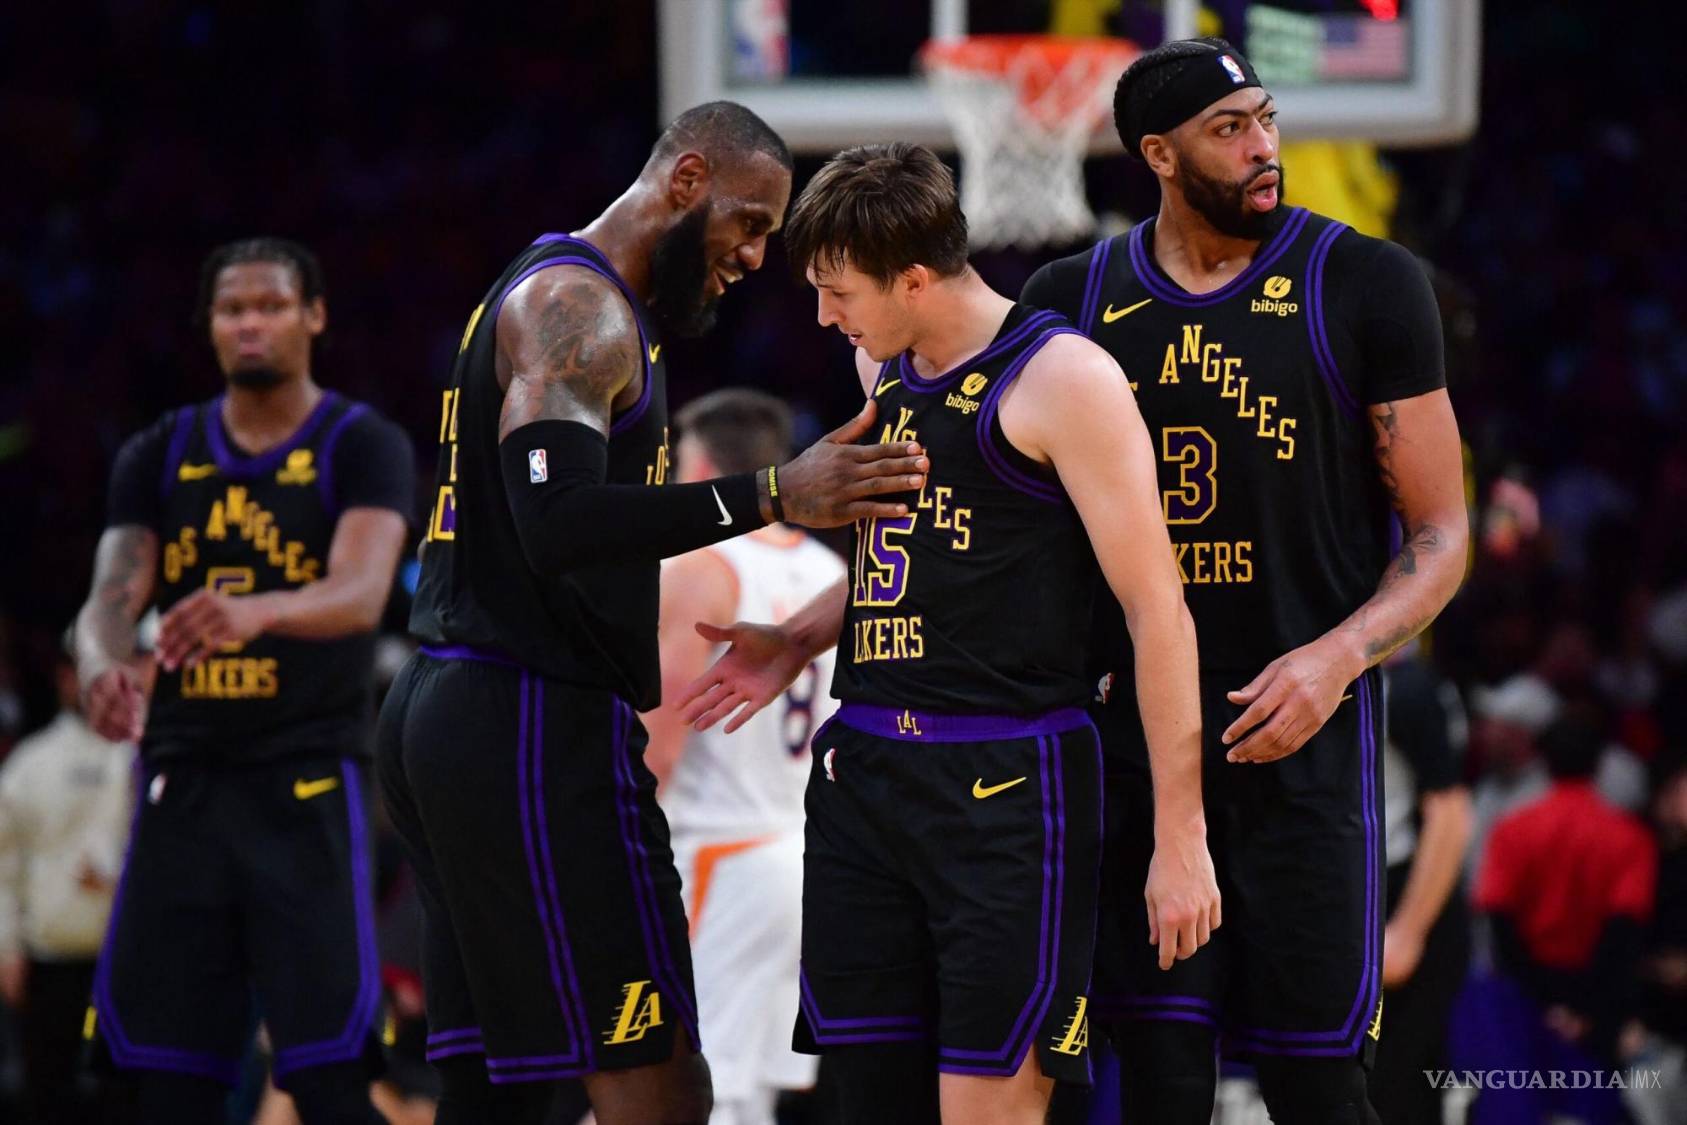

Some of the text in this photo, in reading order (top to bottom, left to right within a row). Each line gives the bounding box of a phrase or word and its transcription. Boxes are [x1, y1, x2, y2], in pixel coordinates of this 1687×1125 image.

[1251, 299, 1298, 316] bibigo
[945, 392, 980, 414] bibigo
[1159, 324, 1296, 460] ANGELES
[1162, 425, 1217, 524] 3
[853, 511, 917, 607] 15
[1171, 541, 1253, 584] KERS
[897, 709, 922, 735] LAL
[603, 979, 662, 1045] LA
